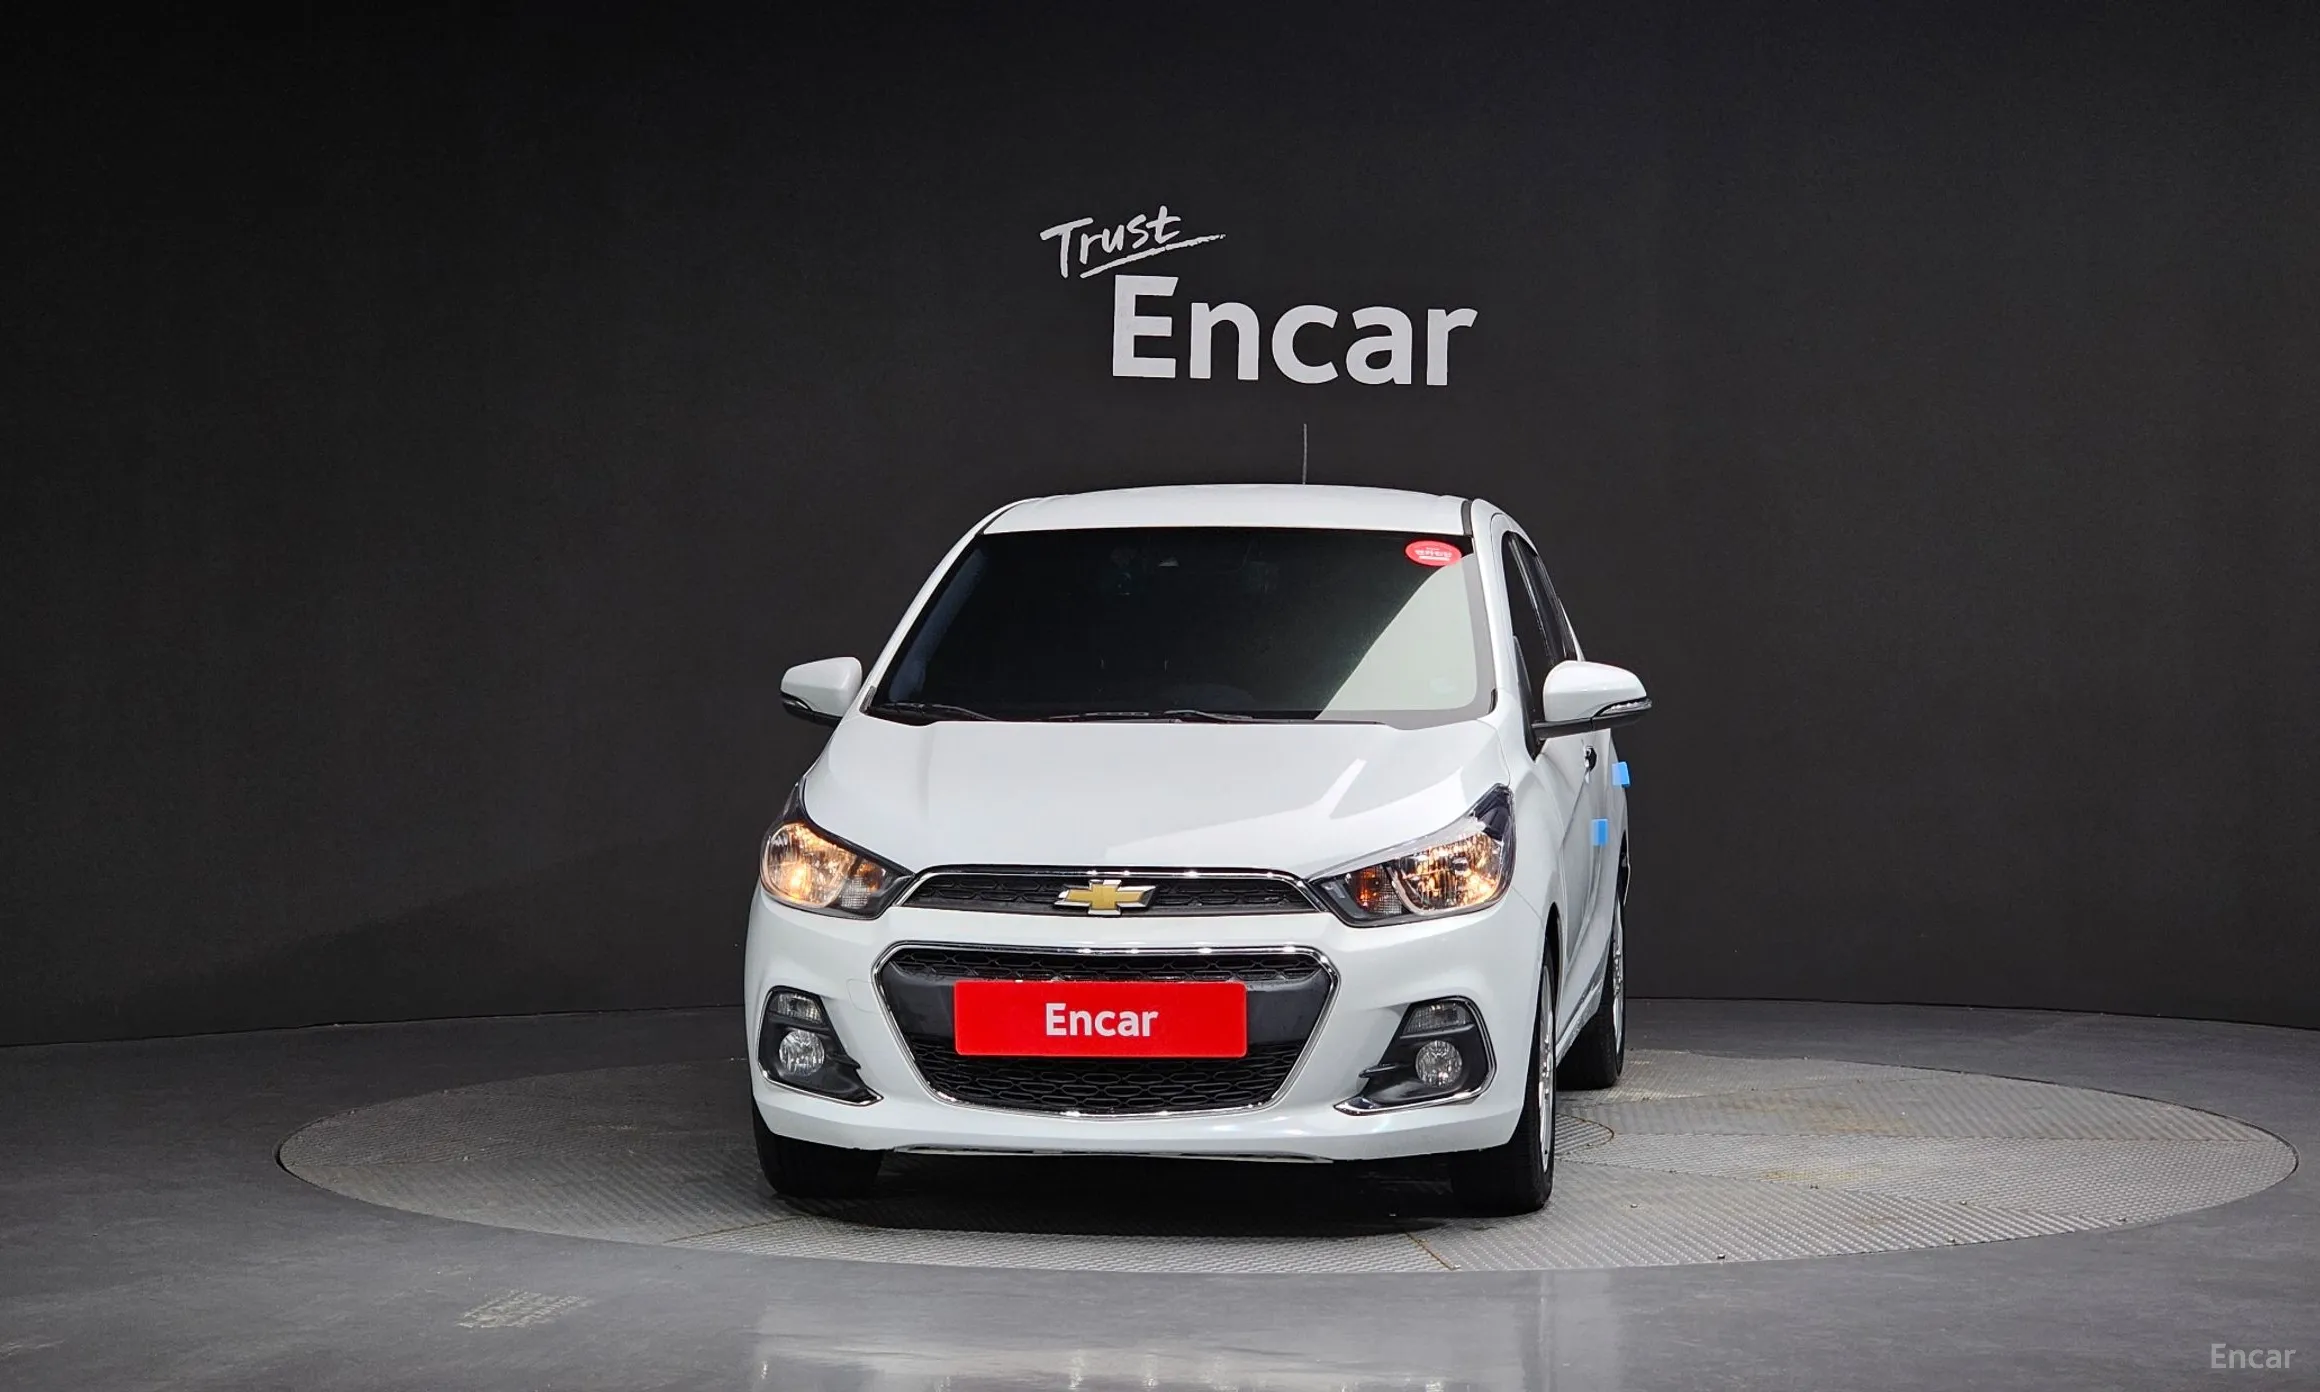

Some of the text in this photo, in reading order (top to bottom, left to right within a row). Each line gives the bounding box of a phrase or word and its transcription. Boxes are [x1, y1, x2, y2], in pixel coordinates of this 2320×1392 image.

[1040, 205, 1183, 279] Trust
[1112, 274, 1478, 386] Encar
[1045, 1002, 1159, 1037] Encar
